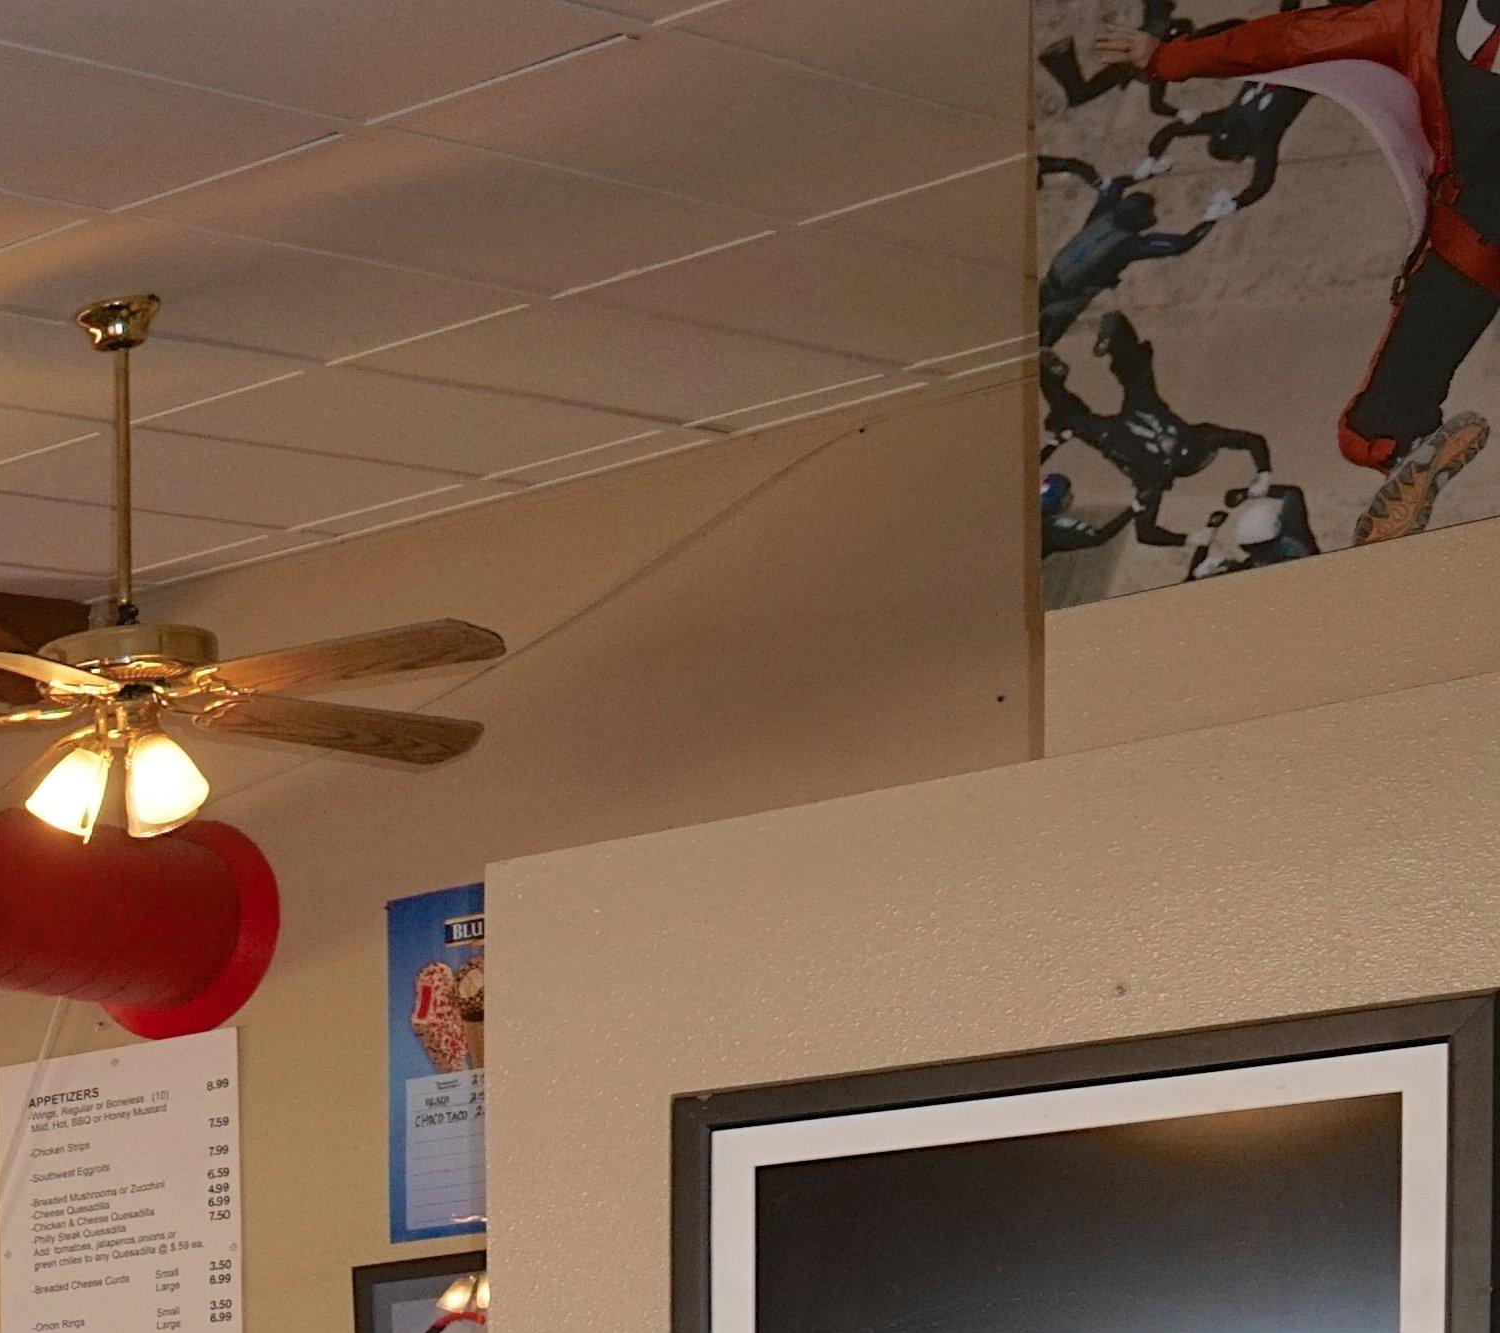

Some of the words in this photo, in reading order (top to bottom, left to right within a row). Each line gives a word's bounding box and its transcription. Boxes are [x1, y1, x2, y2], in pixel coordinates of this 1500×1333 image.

[27, 1087, 99, 1108] APPETIZERS
[60, 1103, 93, 1116] Regular
[95, 1101, 103, 1110] or
[206, 1077, 229, 1091] 8.99
[92, 1114, 102, 1123] or
[103, 1110, 131, 1121] Honey
[208, 1115, 230, 1128] 7.59
[208, 1144, 229, 1156] 7.99
[68, 1188, 117, 1202] Mushrooms
[118, 1186, 128, 1195] or
[207, 1182, 230, 1194] 4.99
[208, 1208, 231, 1221] 7.50
[83, 1254, 93, 1263] to
[154, 1267, 179, 1279] Small
[208, 1258, 232, 1271] 3.50
[154, 1281, 180, 1292] Large
[156, 1305, 180, 1318] Small
[209, 1298, 232, 1310] 3.50
[155, 1319, 181, 1330] Large
